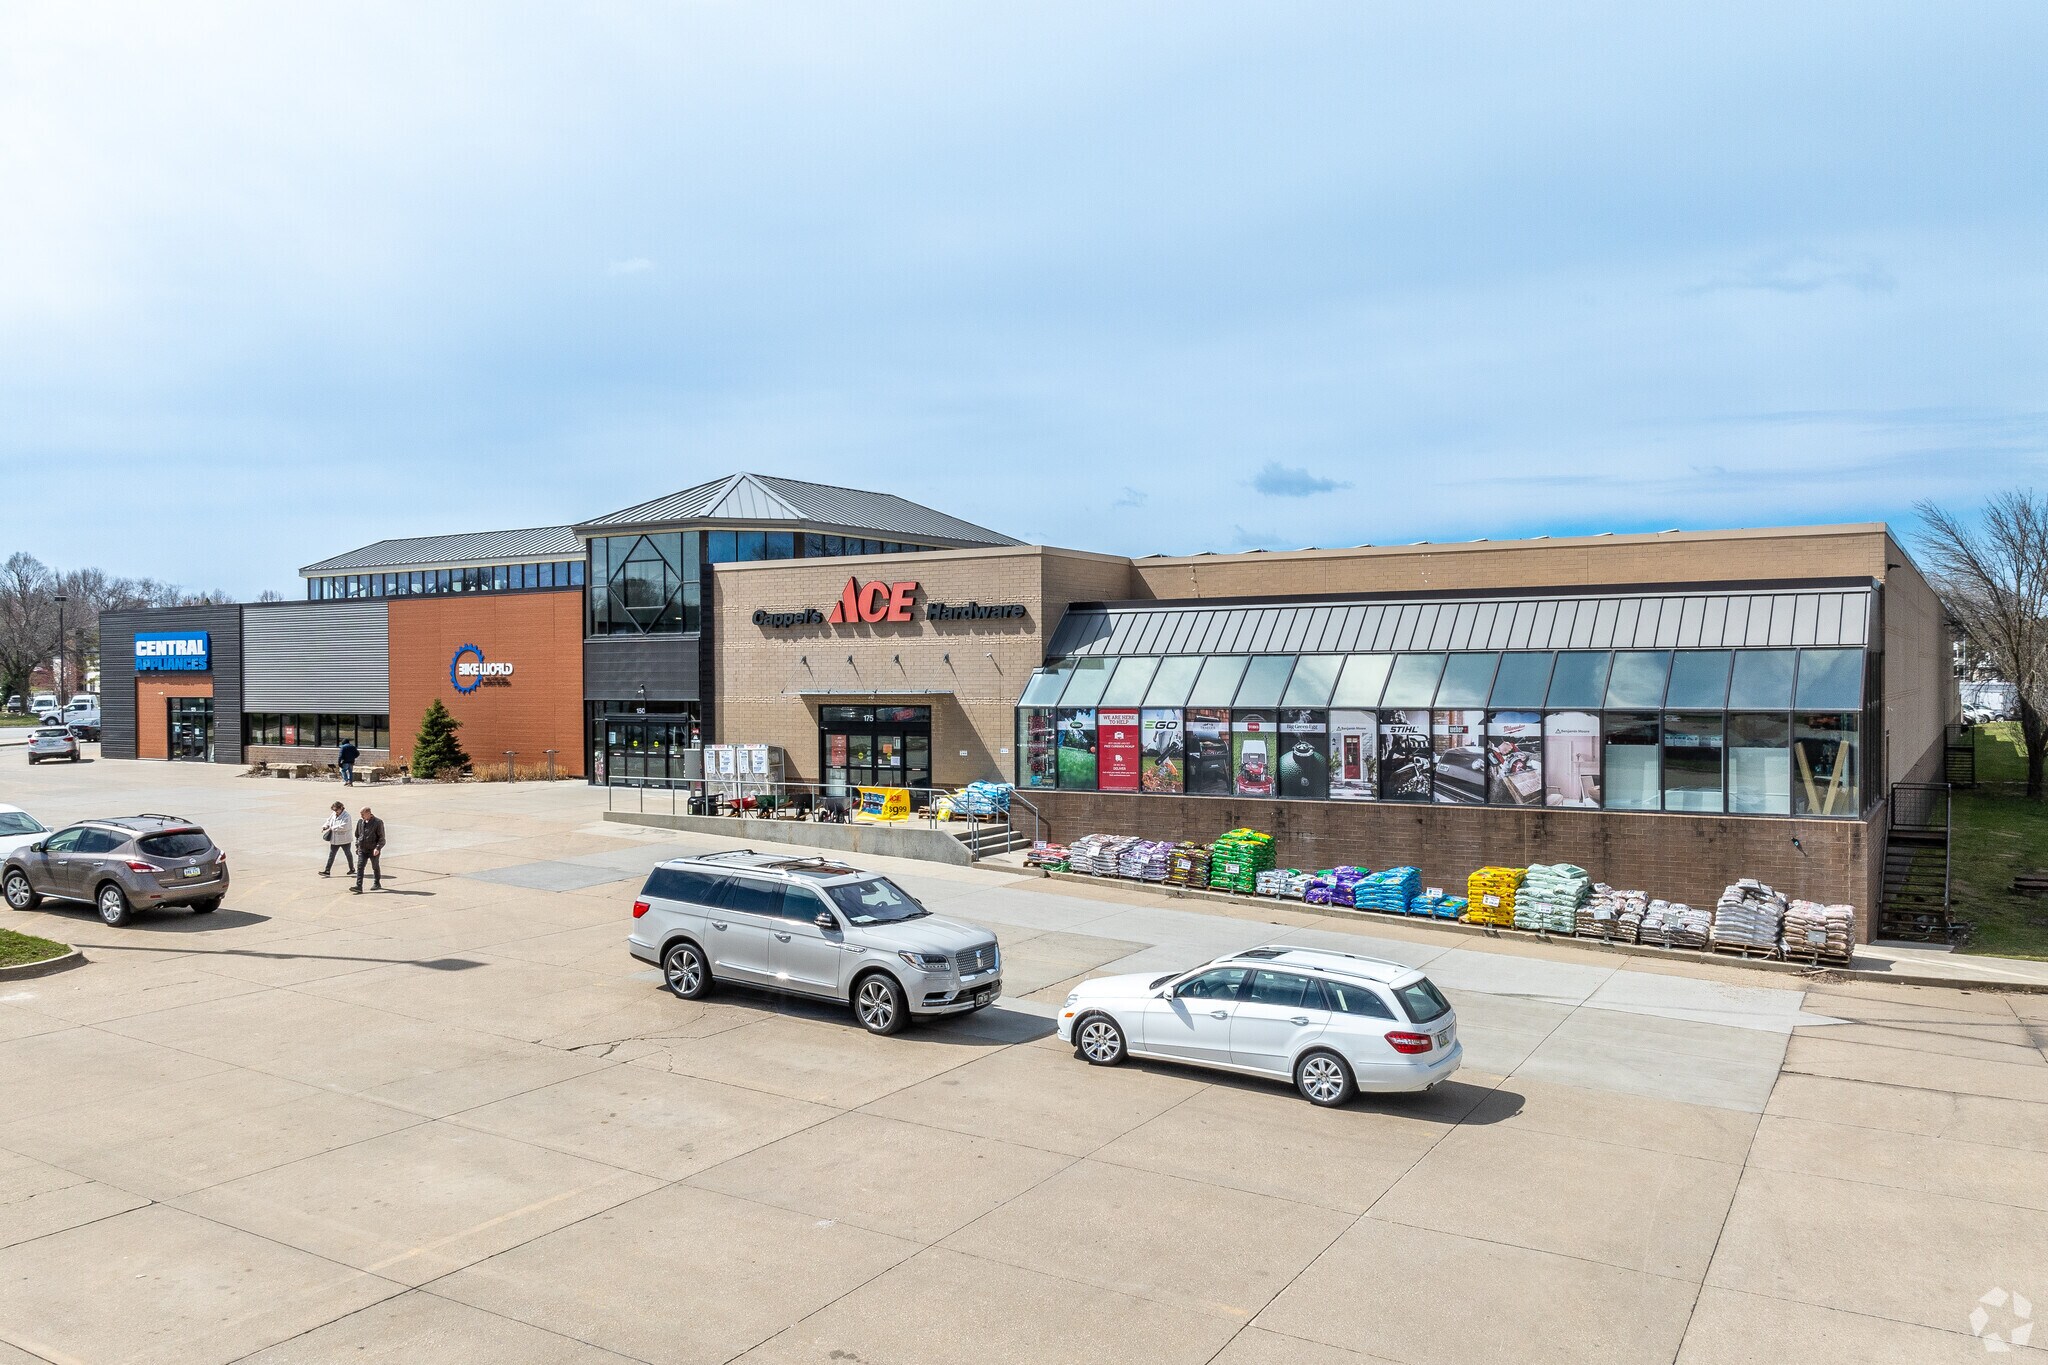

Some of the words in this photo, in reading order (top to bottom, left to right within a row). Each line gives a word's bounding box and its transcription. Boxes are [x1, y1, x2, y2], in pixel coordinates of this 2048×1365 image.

[752, 609, 823, 628] Cappel's
[828, 576, 918, 624] ACE
[926, 602, 1026, 620] Hardware
[135, 640, 206, 656] CENTRAL
[135, 658, 207, 671] APPLIANCES
[863, 714, 874, 722] 175
[1144, 721, 1178, 730] EGO
